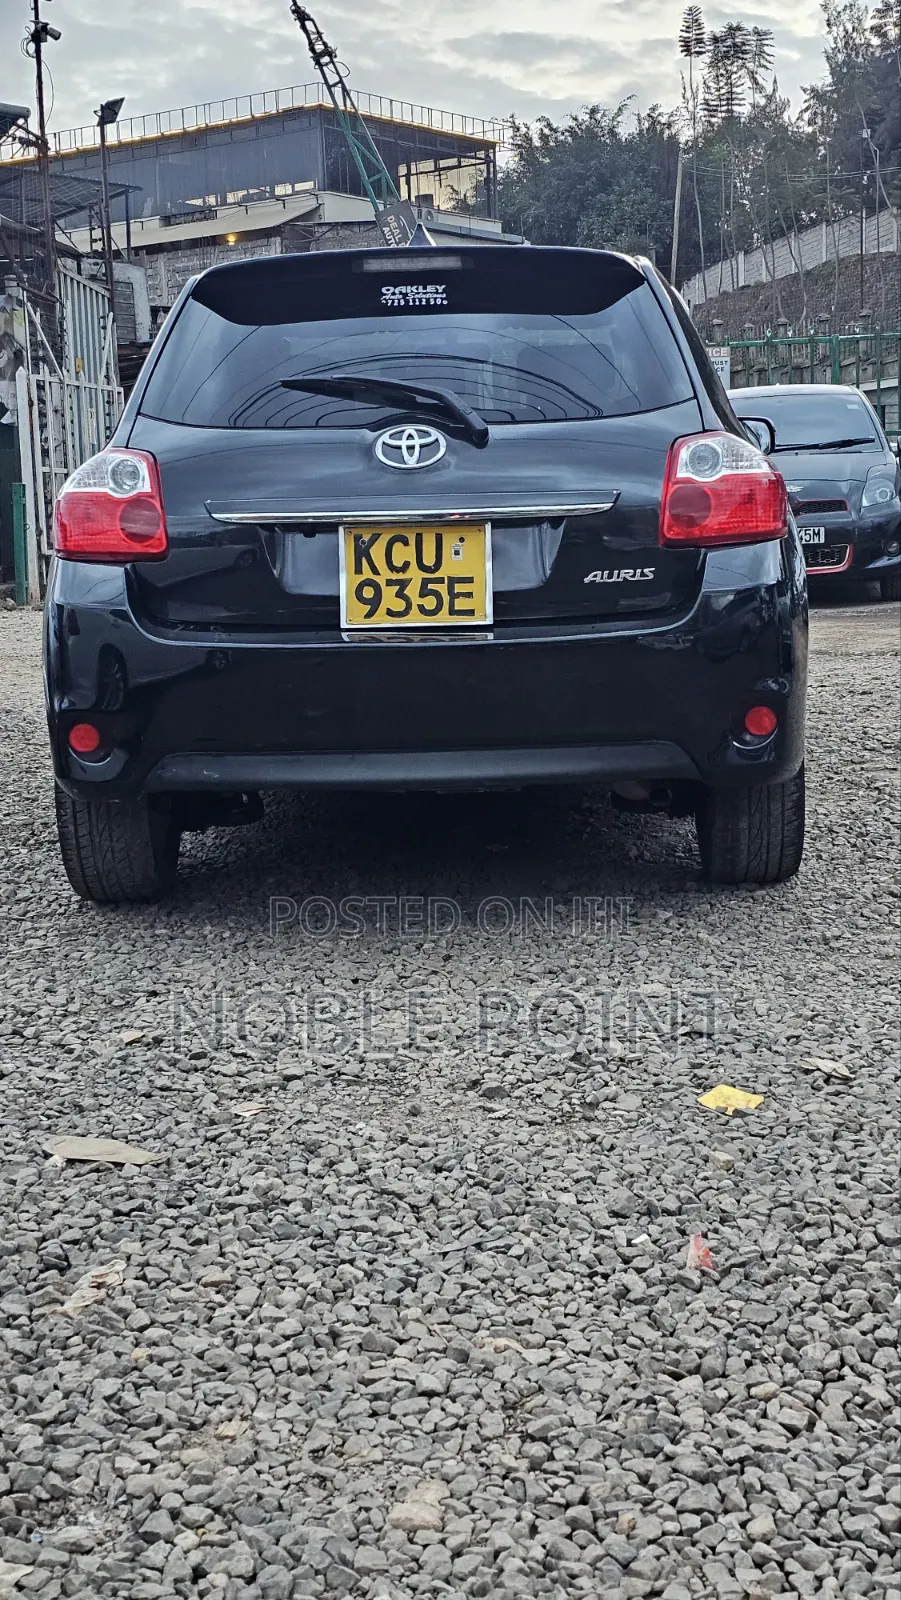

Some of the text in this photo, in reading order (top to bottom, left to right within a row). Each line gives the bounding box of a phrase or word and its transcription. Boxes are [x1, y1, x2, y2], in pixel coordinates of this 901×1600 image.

[387, 215, 402, 242] DEAL
[381, 285, 446, 294] OAKLEY
[353, 533, 443, 575] KCU
[583, 567, 656, 584] AURIS
[354, 576, 476, 619] 935E
